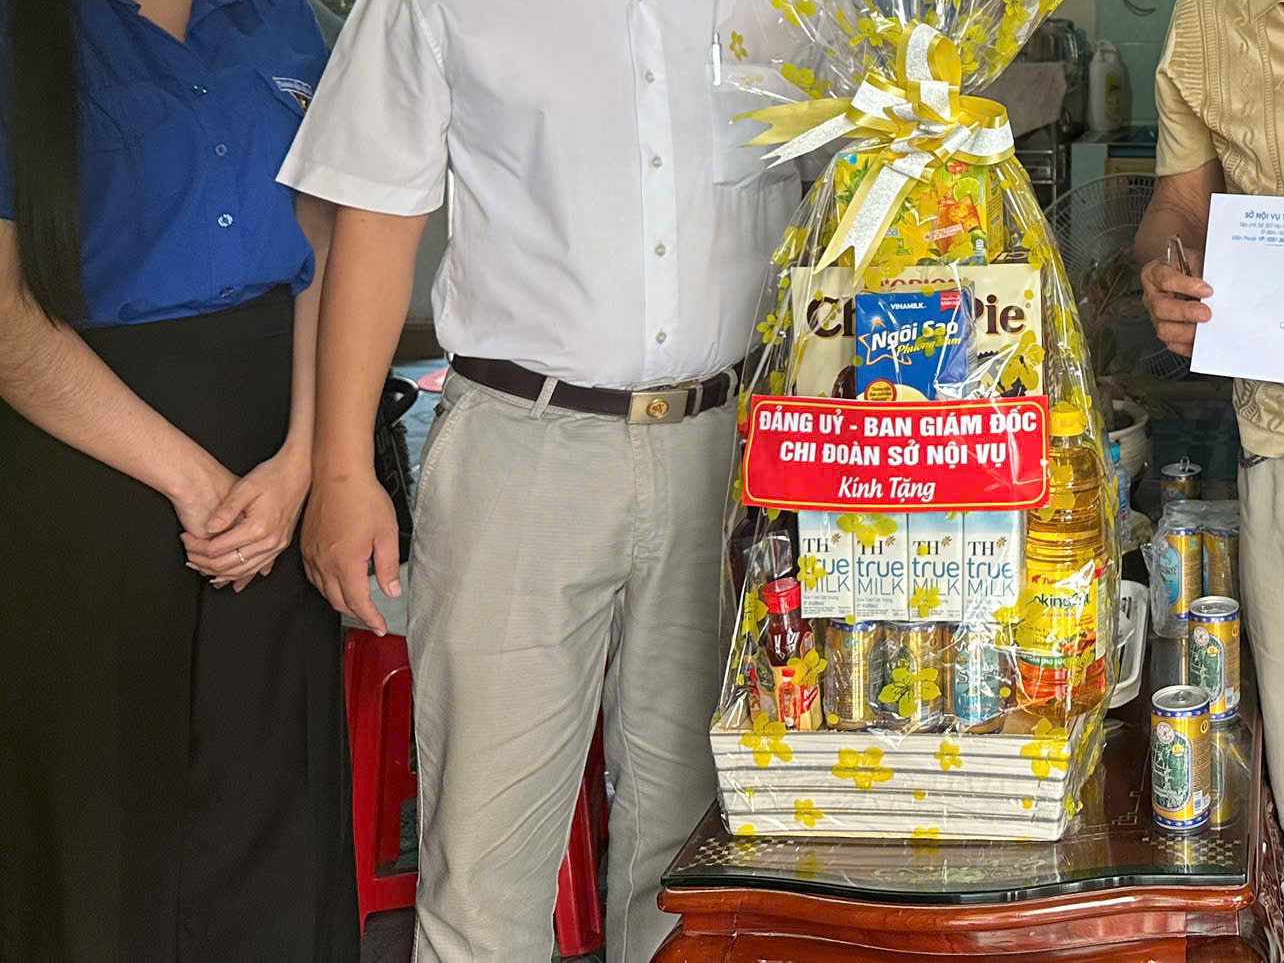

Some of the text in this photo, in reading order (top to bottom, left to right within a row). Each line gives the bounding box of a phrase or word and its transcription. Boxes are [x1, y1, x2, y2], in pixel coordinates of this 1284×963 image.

[891, 302, 926, 310] VINAMILK
[871, 320, 959, 351] Ngôi Sao
[759, 404, 813, 433] ĐẢNG
[819, 405, 844, 435] UỶ
[864, 417, 912, 437] BAN
[920, 410, 984, 437] GIÁM
[989, 405, 1037, 433] ĐỐC
[780, 439, 1007, 469] CHI ĐOÀN SỞ NỘI VỤ
[838, 476, 937, 502] Kính Tặng
[803, 538, 830, 553] TH
[913, 541, 940, 555] TH
[968, 541, 995, 556] TH
[856, 557, 904, 578] true
[912, 557, 960, 578] true
[966, 557, 1014, 579] true
[858, 577, 905, 595] MILK
[967, 578, 1015, 597] MILK
